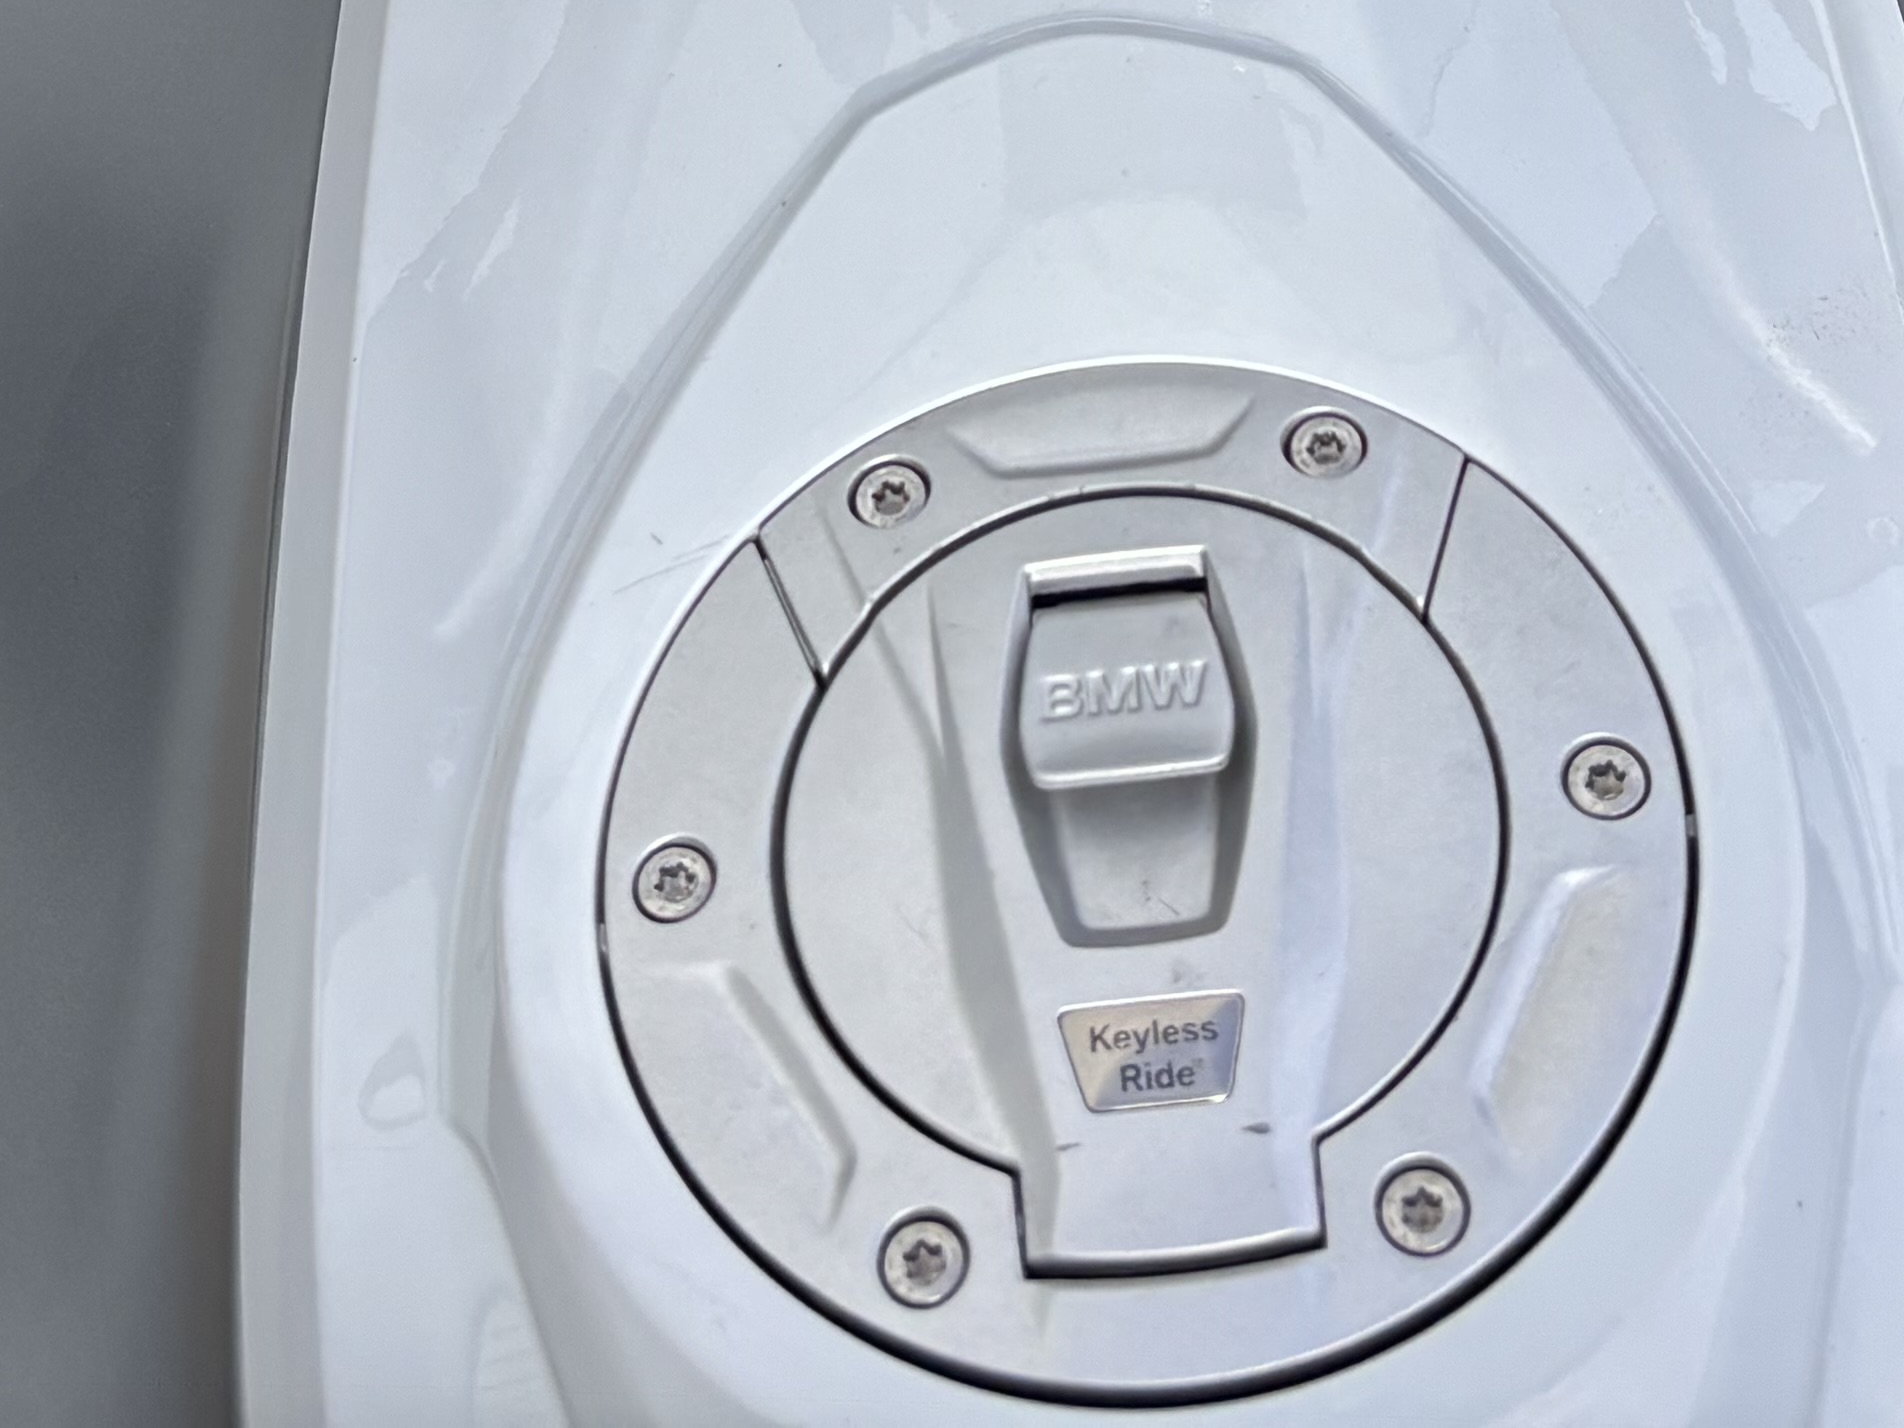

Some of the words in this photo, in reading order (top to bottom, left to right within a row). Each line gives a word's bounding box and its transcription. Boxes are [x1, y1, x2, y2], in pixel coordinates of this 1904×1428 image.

[1040, 659, 1208, 724] BMW
[1088, 1018, 1221, 1055] Keyless
[1119, 1058, 1197, 1093] Ride
